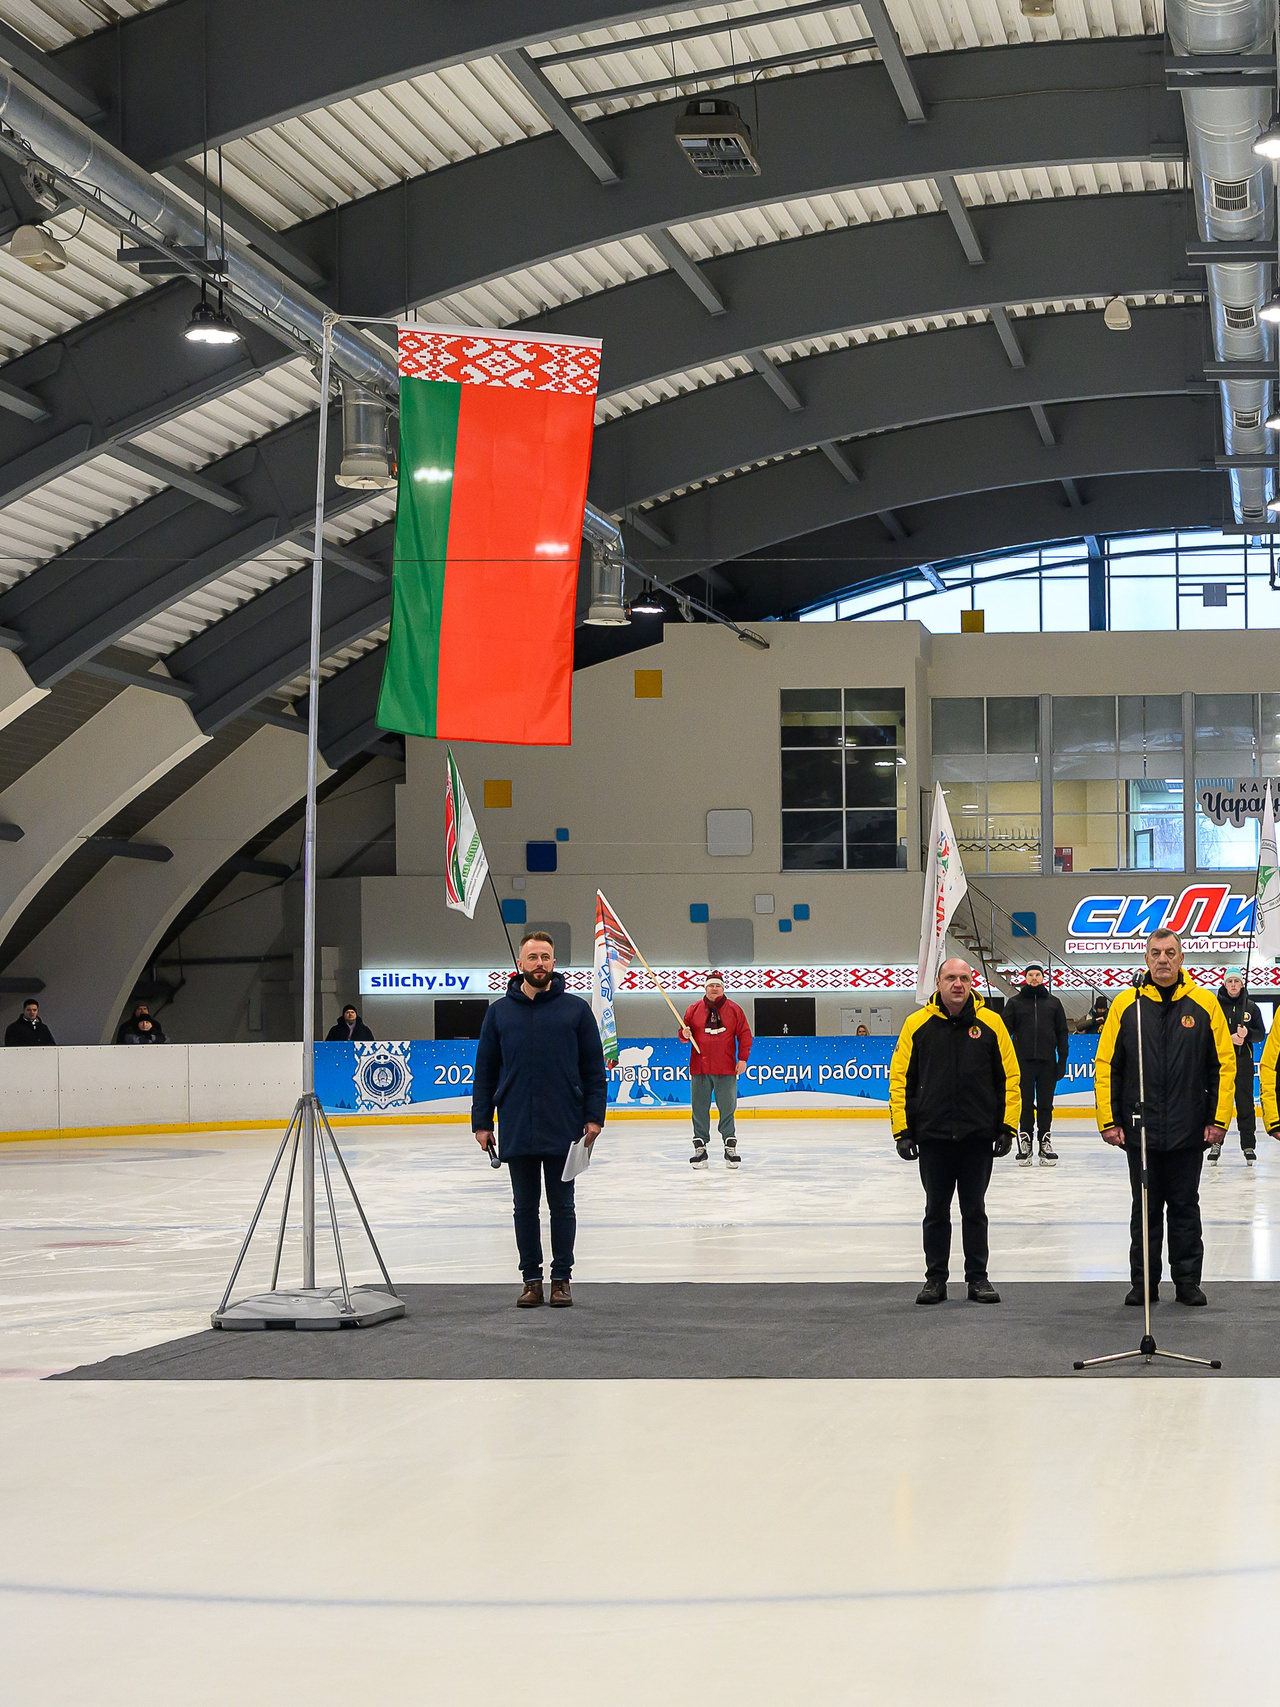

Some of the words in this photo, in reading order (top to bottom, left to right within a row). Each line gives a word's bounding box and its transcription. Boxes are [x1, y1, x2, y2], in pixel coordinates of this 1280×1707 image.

[1068, 940, 1209, 950] РЕСПУБЛИККИЙ
[370, 972, 471, 991] silichy.by
[434, 1064, 475, 1085] 202
[745, 1064, 812, 1085] среди
